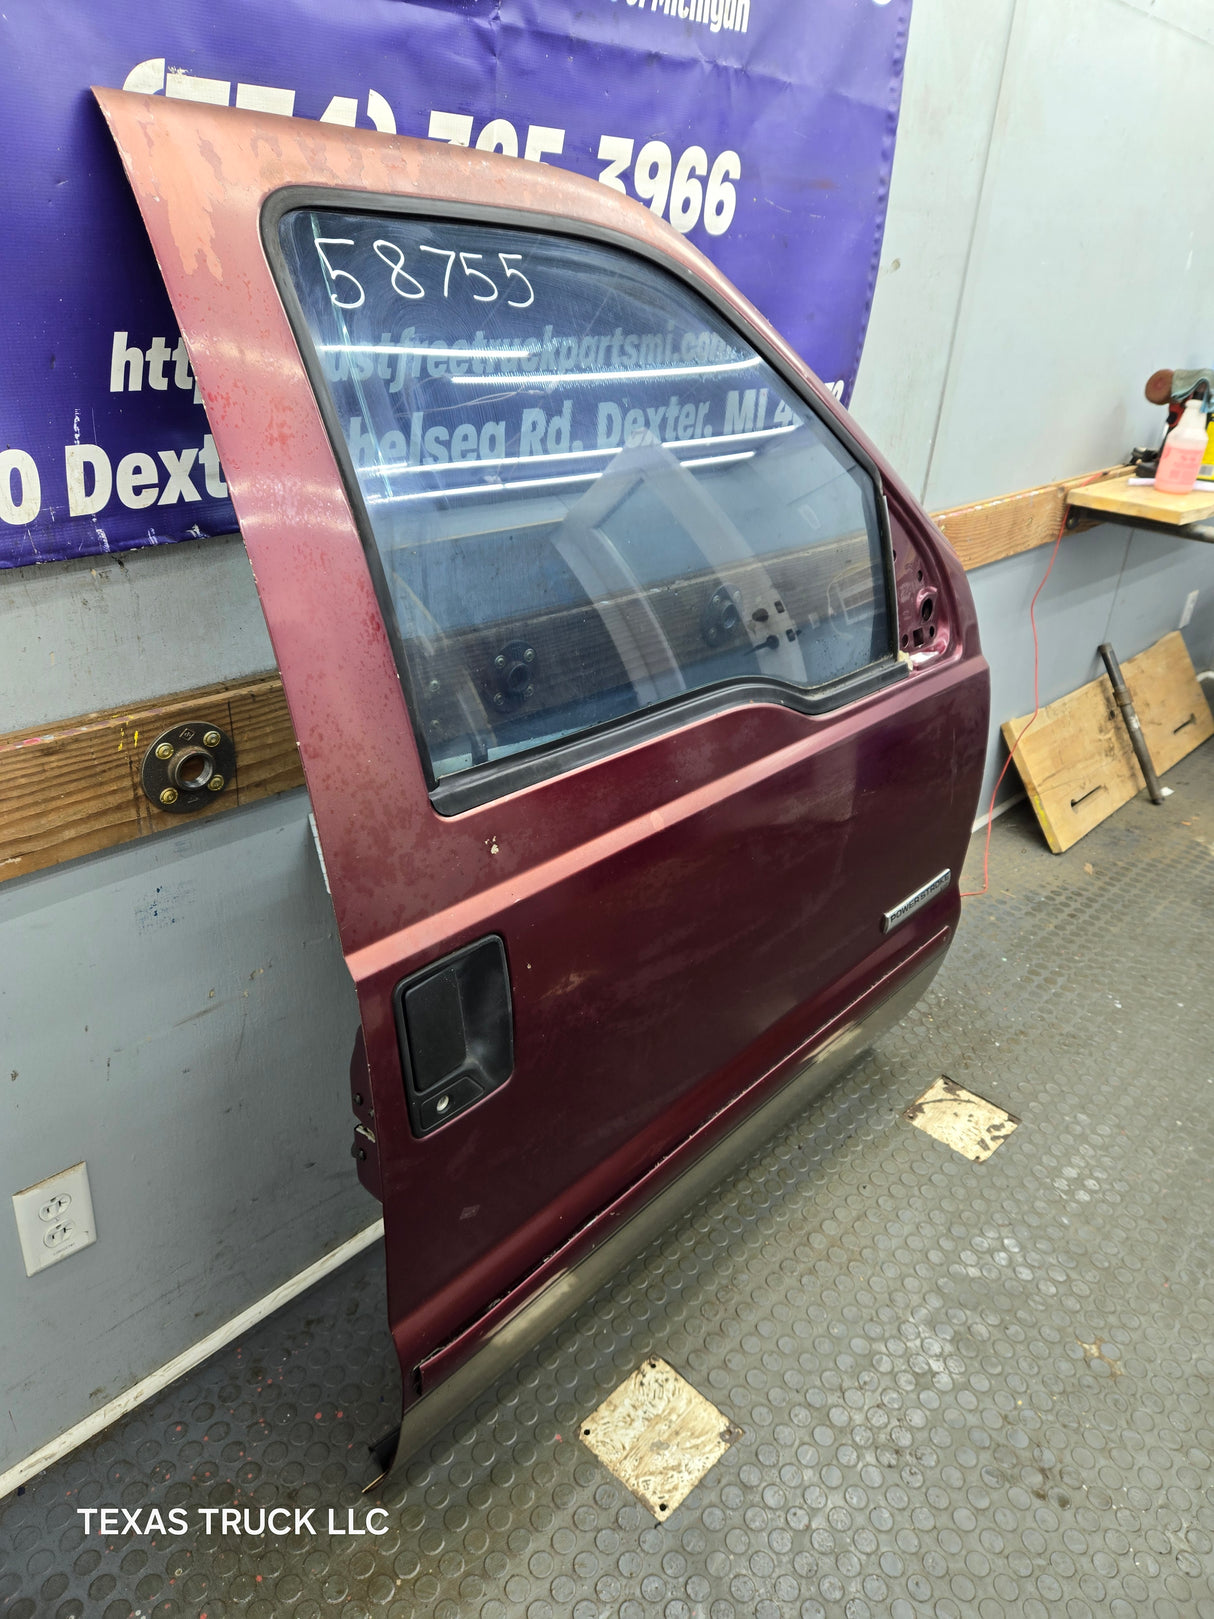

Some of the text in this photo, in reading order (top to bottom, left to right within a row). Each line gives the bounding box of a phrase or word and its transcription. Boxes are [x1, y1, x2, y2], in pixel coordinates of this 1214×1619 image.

[649, 0, 750, 33] cigan
[597, 134, 741, 236] 3966
[314, 238, 534, 309] 58755
[110, 321, 735, 405] htt ustfreetruckpartsmi.com
[65, 434, 229, 517] Dext
[350, 411, 506, 467] helsea
